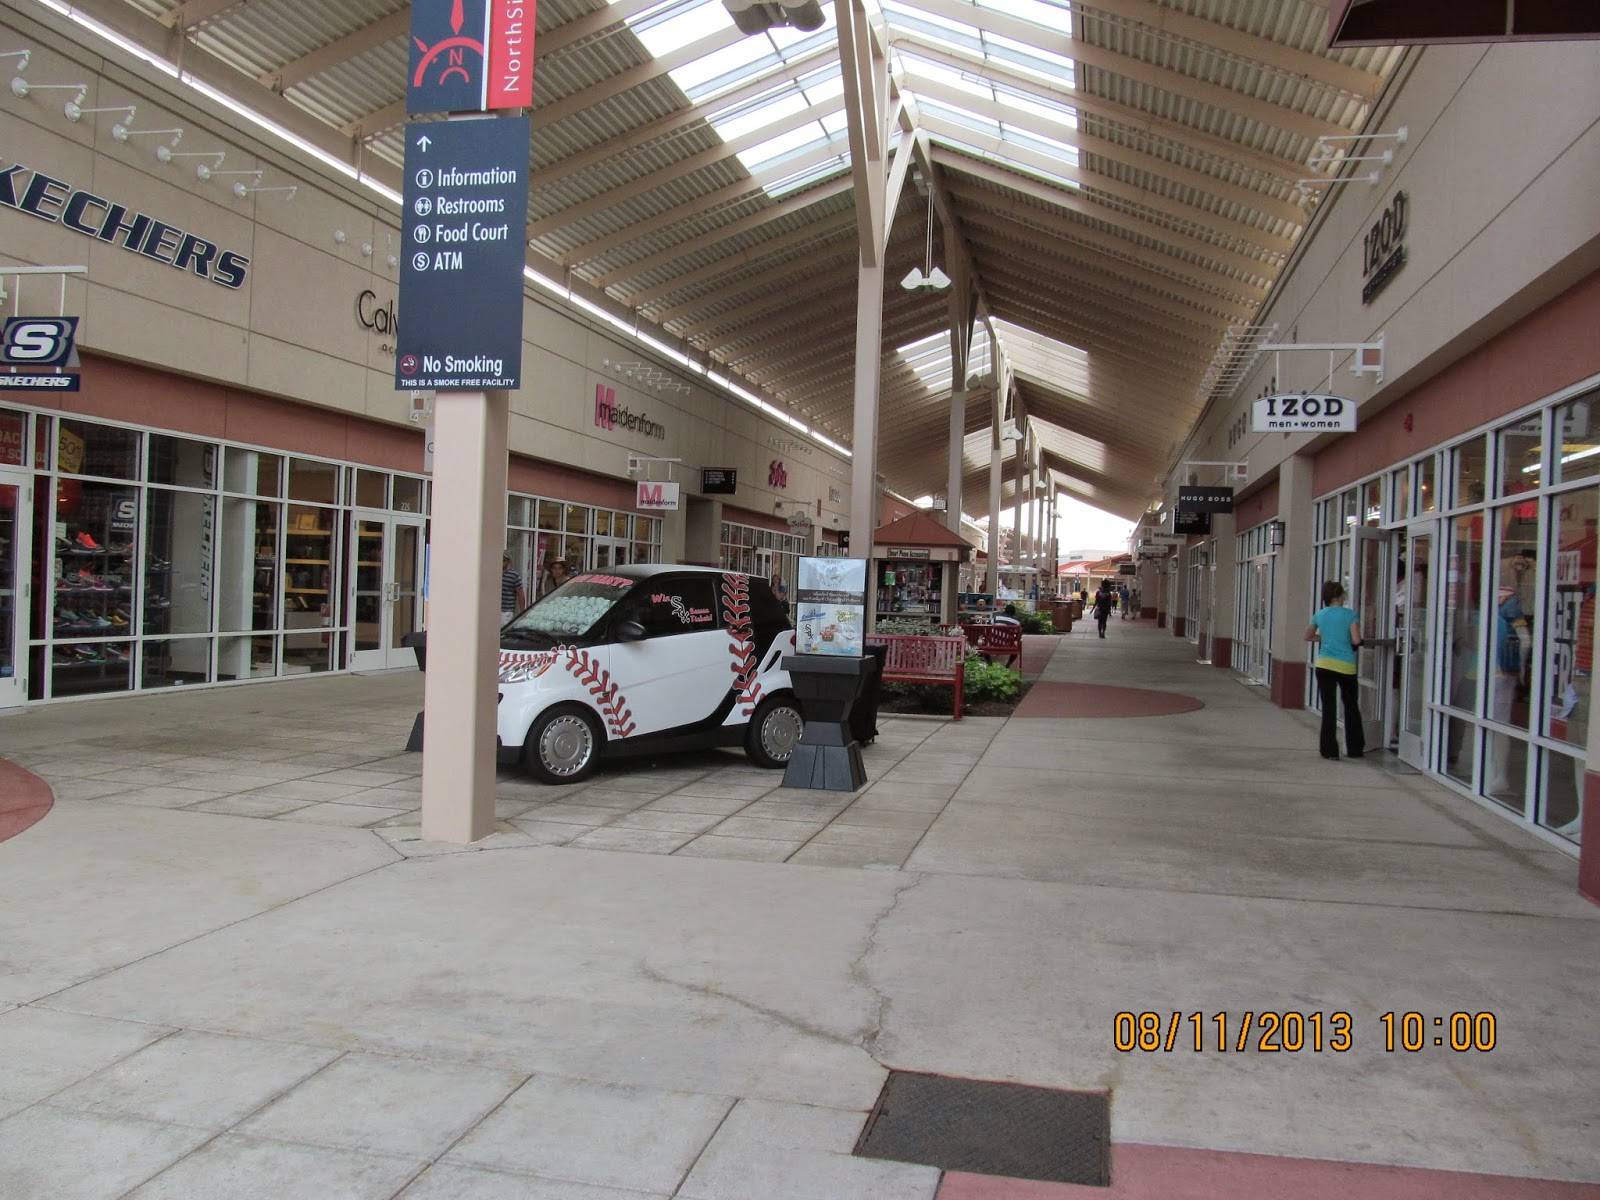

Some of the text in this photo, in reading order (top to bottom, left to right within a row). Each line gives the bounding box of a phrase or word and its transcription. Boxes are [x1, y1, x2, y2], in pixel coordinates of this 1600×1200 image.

[449, 48, 463, 66] N
[438, 167, 517, 187] Information
[437, 197, 505, 215] Restrooms
[435, 222, 508, 242] Food Court
[1363, 190, 1404, 278] IZOD
[434, 251, 463, 271] ATM
[423, 355, 503, 376] No Smoking
[0, 376, 71, 387] SKECHERS
[401, 379, 417, 387] THIS
[1267, 398, 1343, 416] IZOD
[599, 402, 665, 440] maidenform
[640, 497, 676, 507] maidenform
